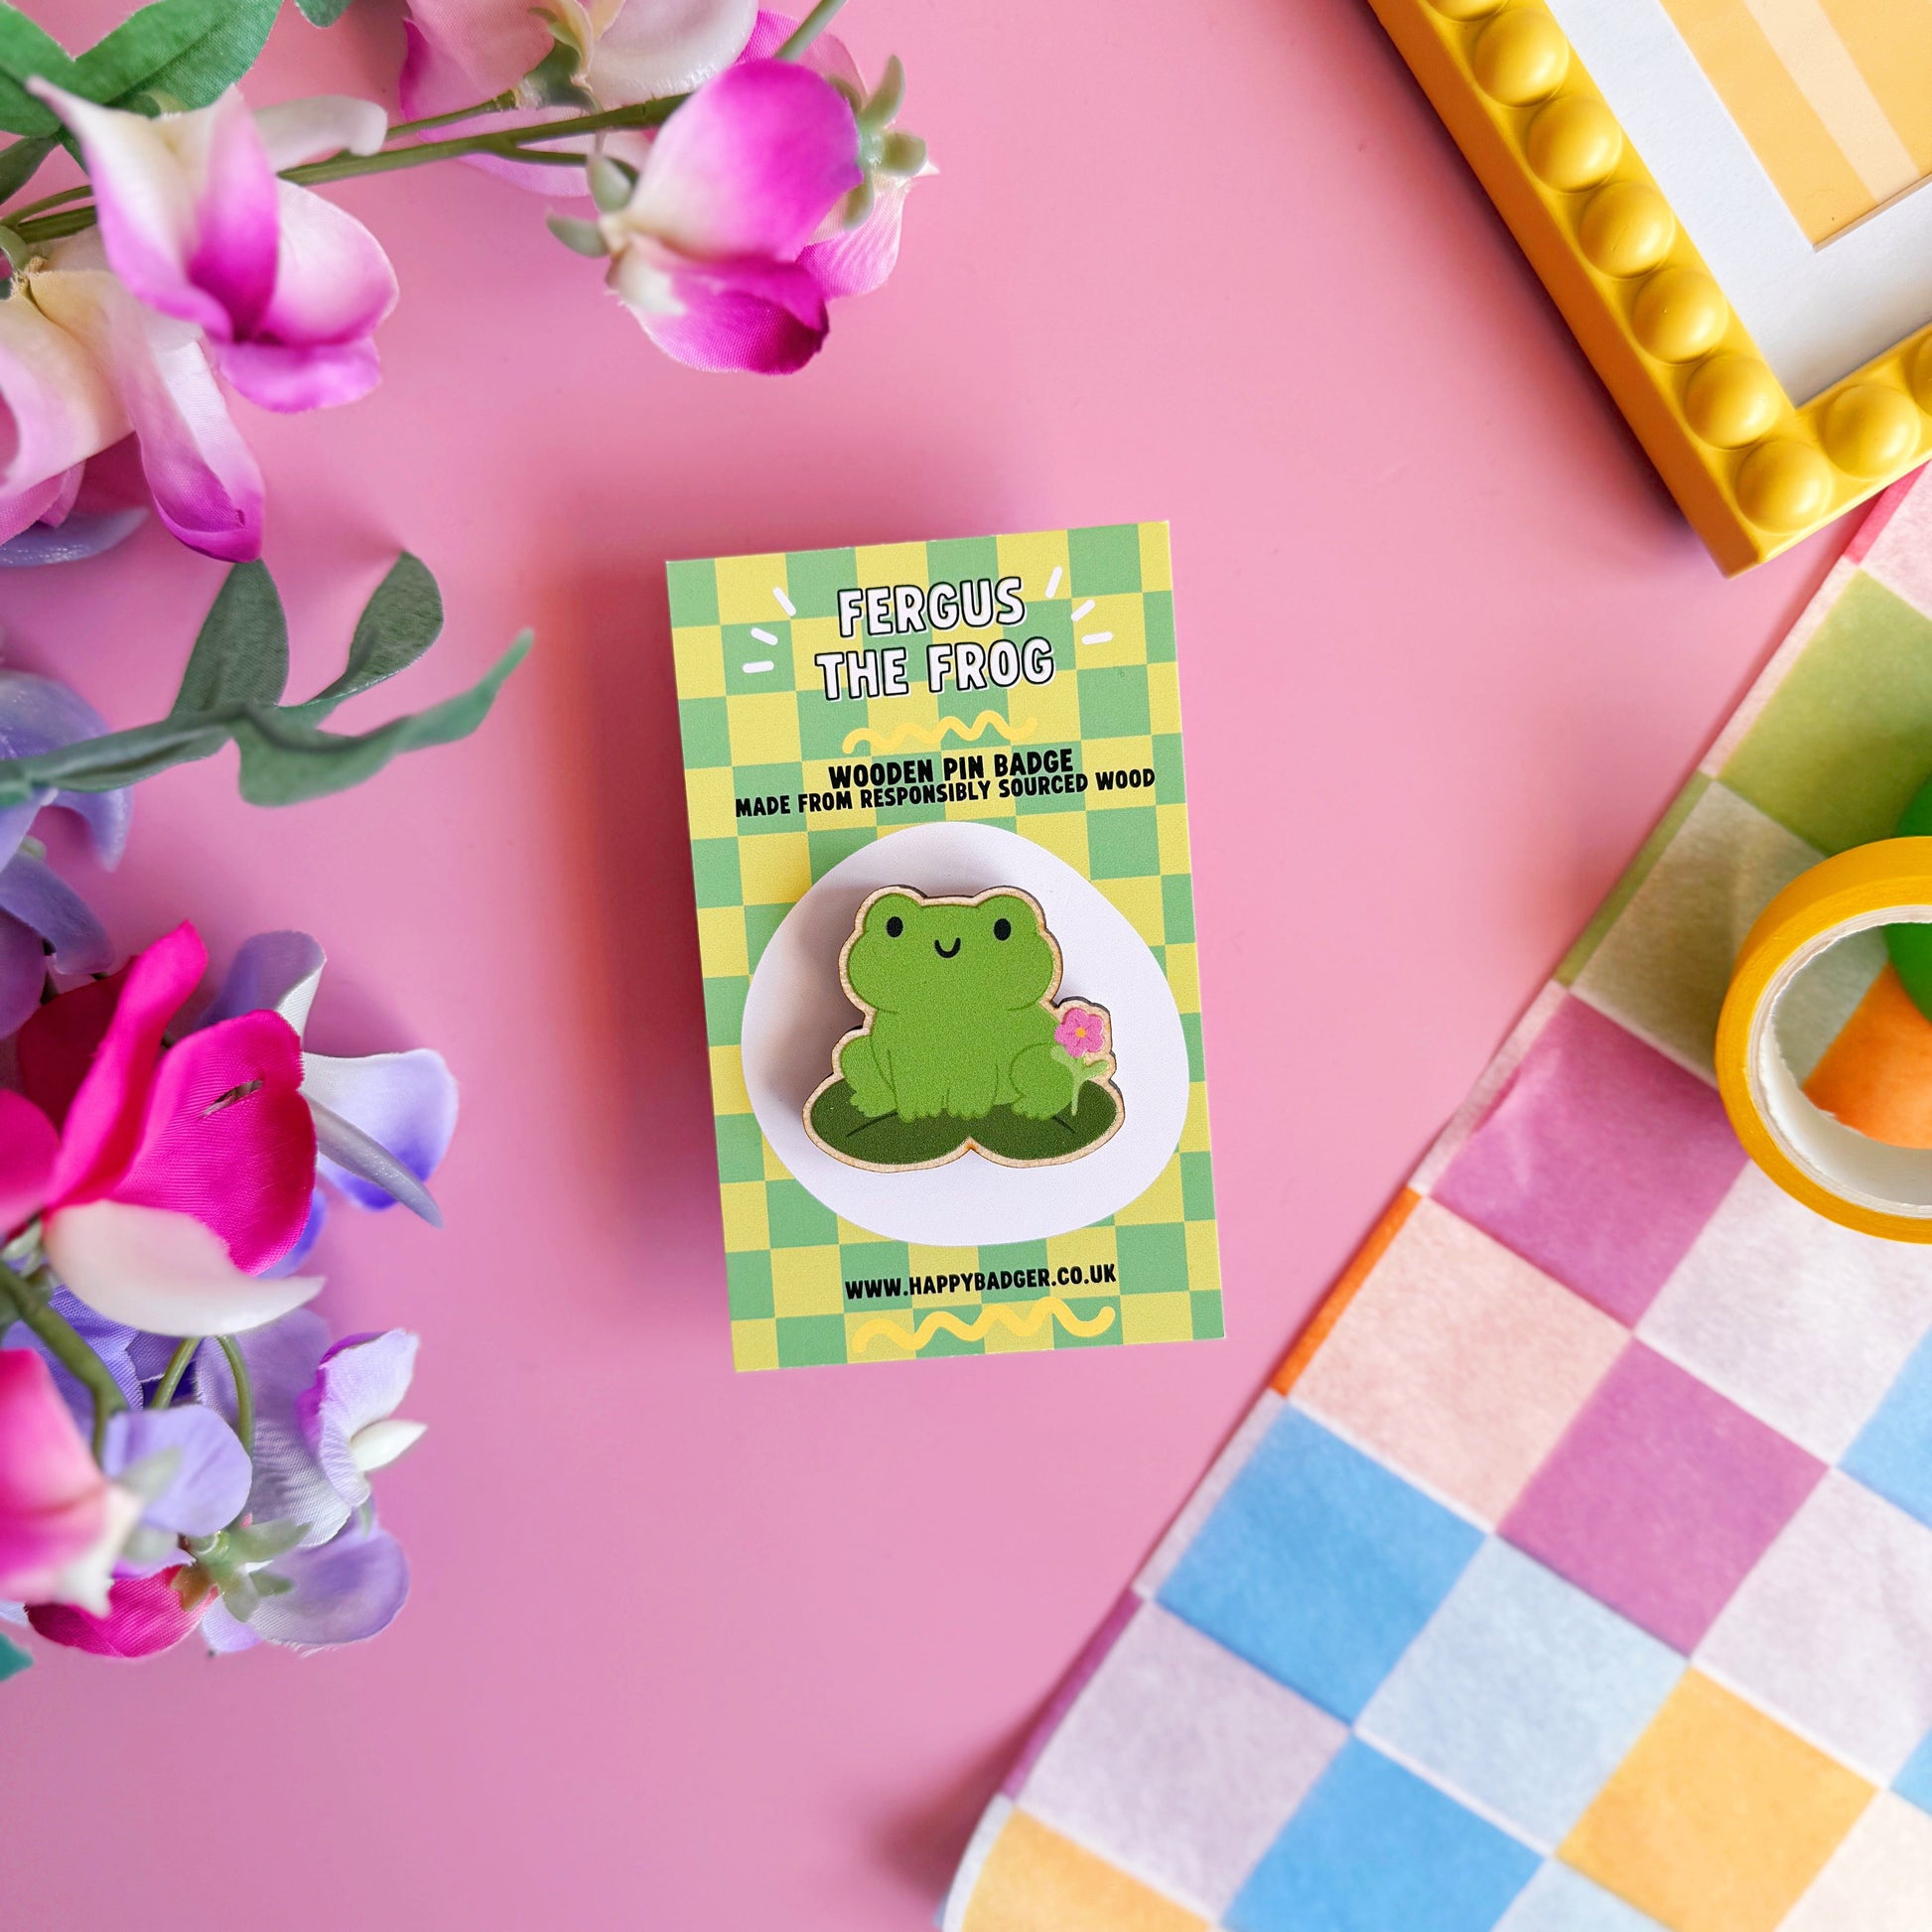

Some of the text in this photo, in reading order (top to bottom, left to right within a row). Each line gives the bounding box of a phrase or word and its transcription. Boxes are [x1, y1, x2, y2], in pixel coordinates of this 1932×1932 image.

[837, 577, 1025, 637] FERGUS
[814, 636, 1053, 701] THE FROG
[736, 768, 1155, 817] MADE FROM RESPONSIBLY SOURCED WOOD
[829, 749, 1073, 788] WOODEN PIN BADGE
[845, 1264, 1116, 1300] WWW.HAPPYBADGER.CO.UK
